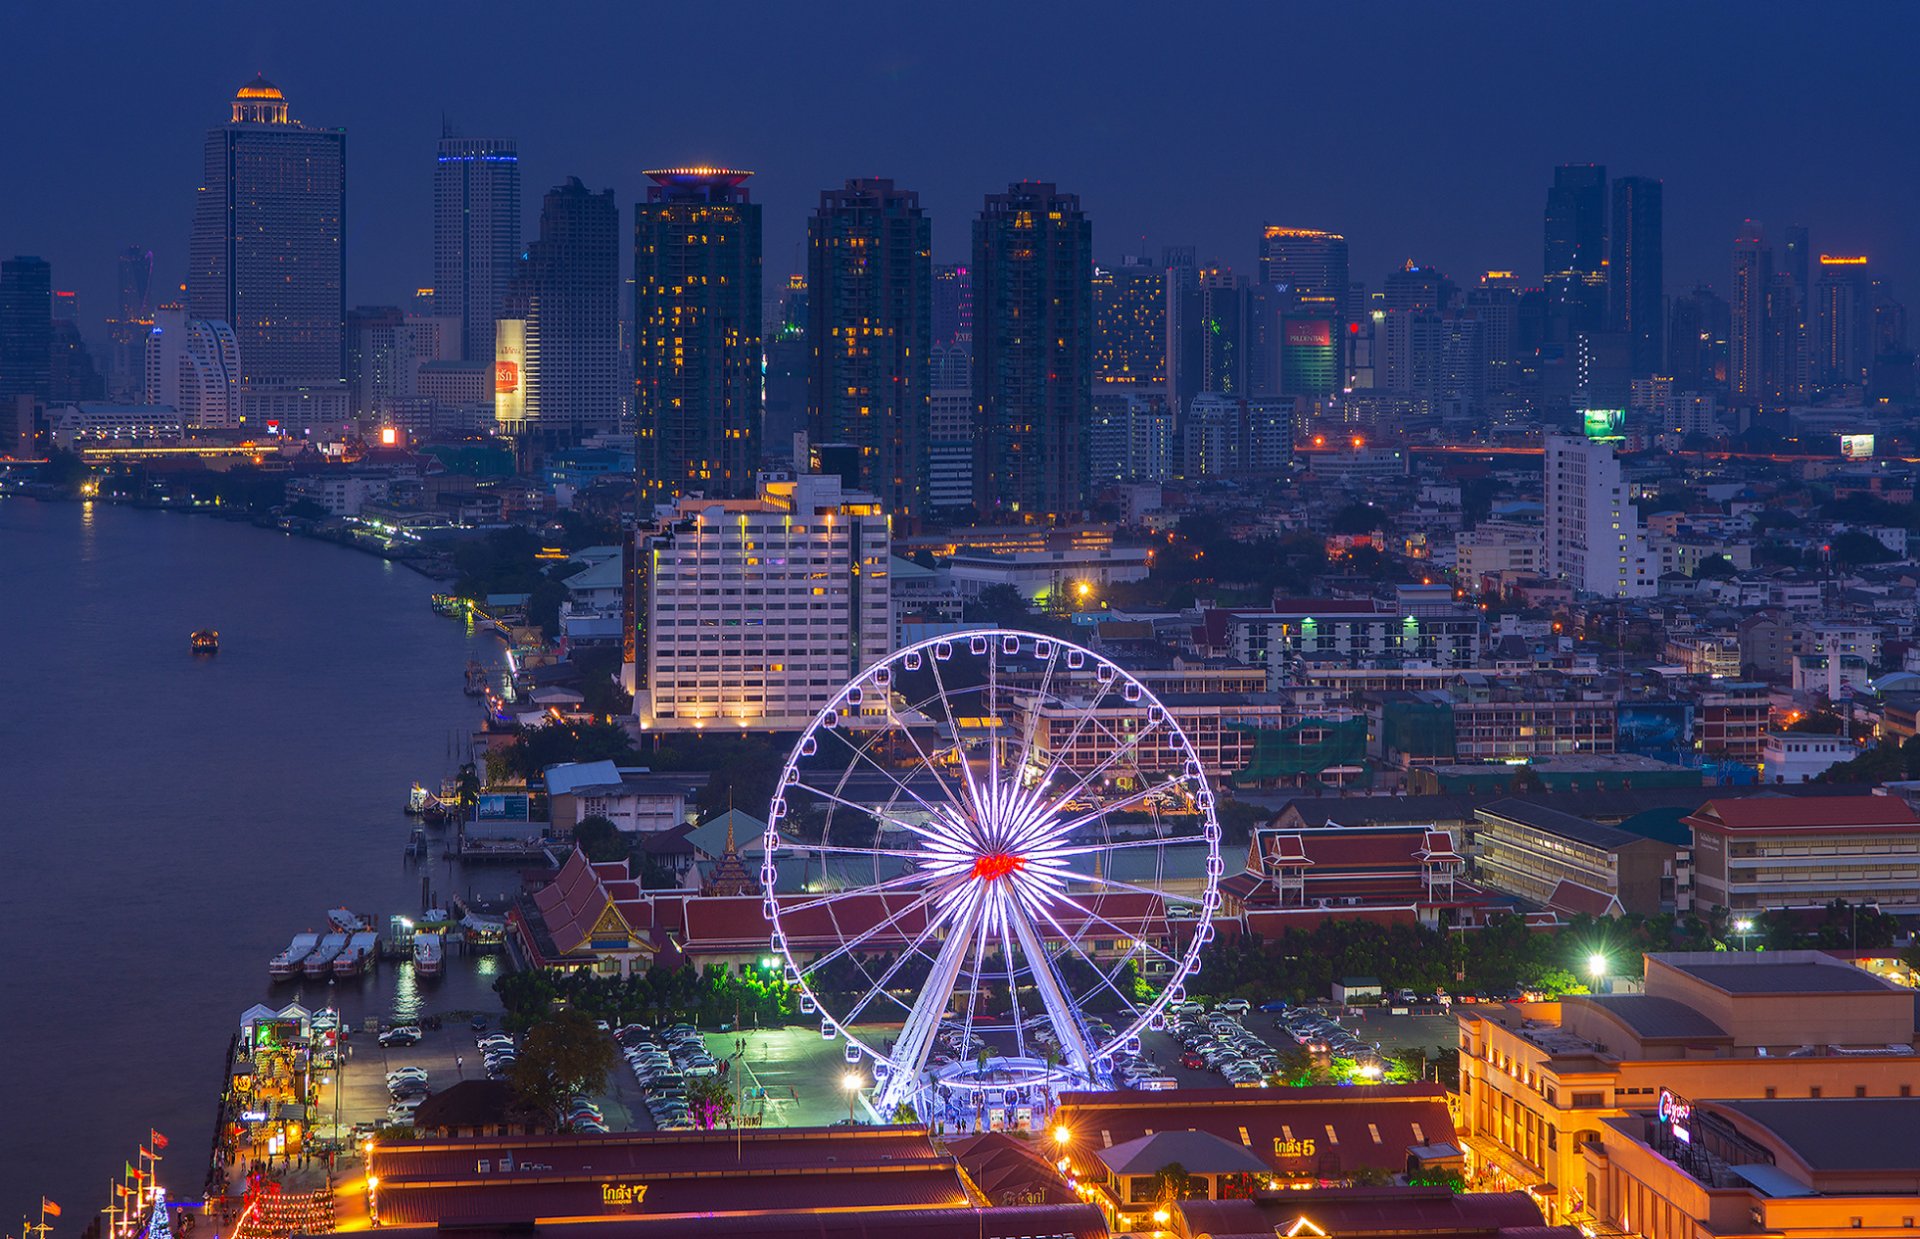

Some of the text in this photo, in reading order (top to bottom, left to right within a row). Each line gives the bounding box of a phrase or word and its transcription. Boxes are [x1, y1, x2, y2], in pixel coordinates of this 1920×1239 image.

[1273, 1137, 1316, 1156] โกดัง 5
[601, 1184, 648, 1203] โกดัง 7
